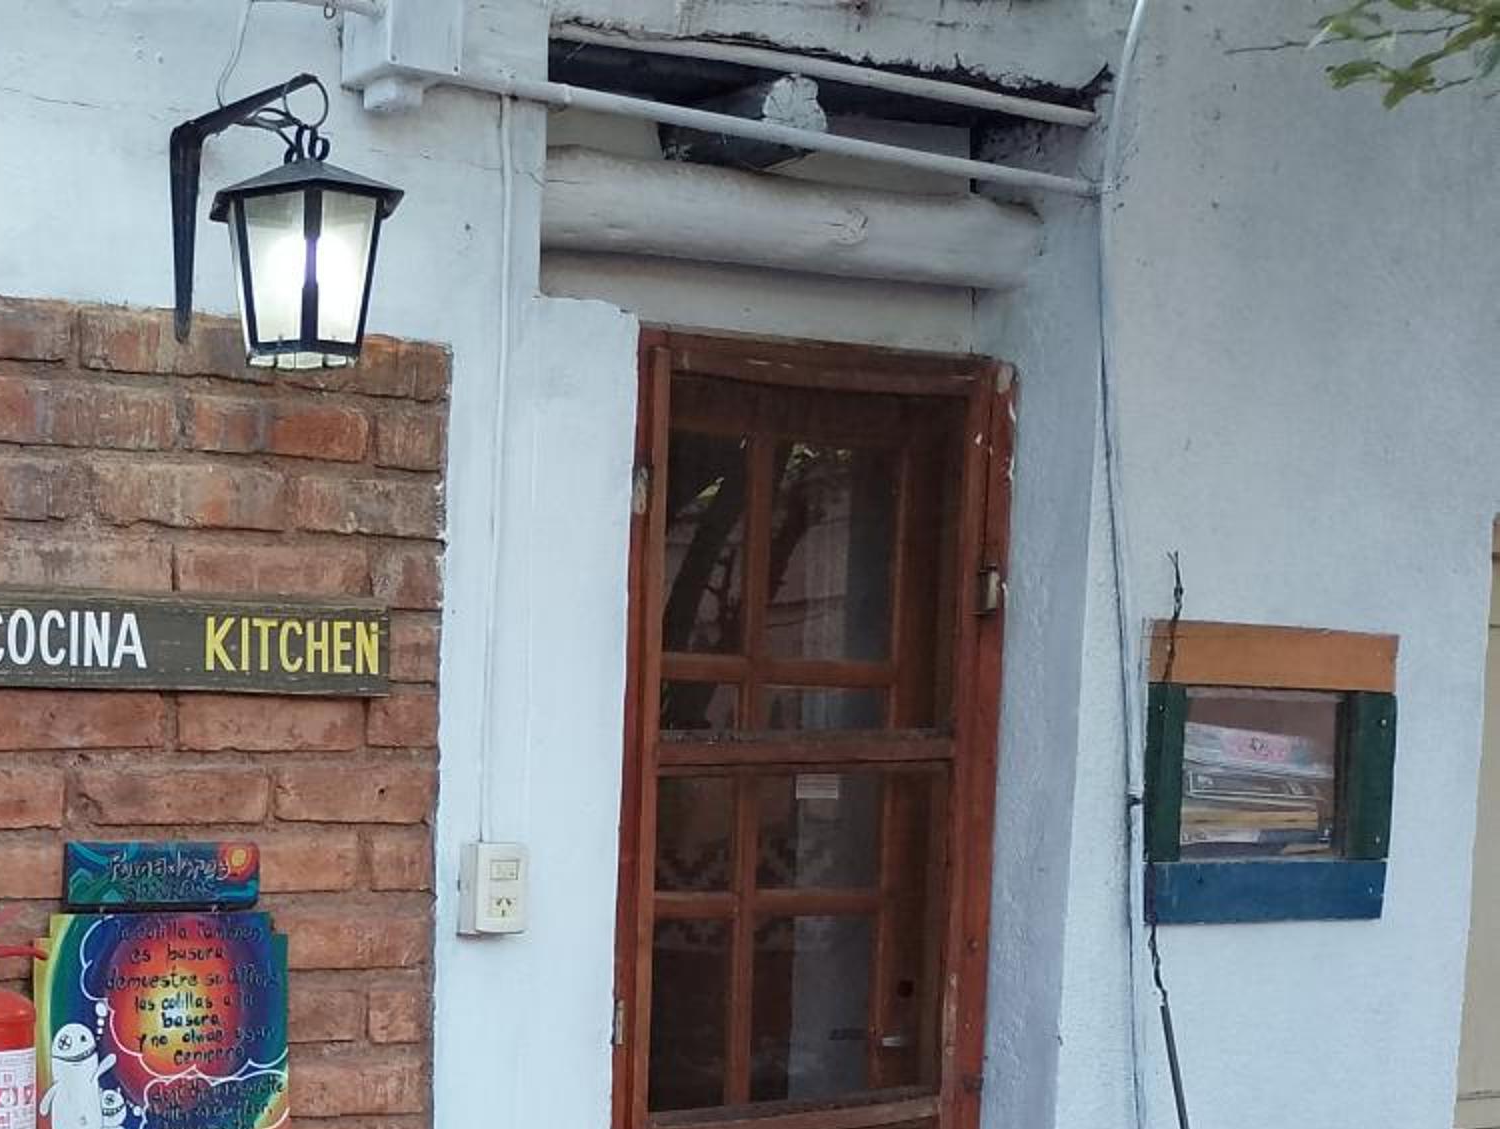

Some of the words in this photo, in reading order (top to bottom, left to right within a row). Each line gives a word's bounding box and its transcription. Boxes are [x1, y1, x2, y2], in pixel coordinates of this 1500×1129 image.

[204, 616, 380, 675] KITCHEN
[131, 948, 152, 964] es
[135, 996, 156, 1013] las
[161, 991, 213, 1010] colillas
[151, 1034, 169, 1048] no
